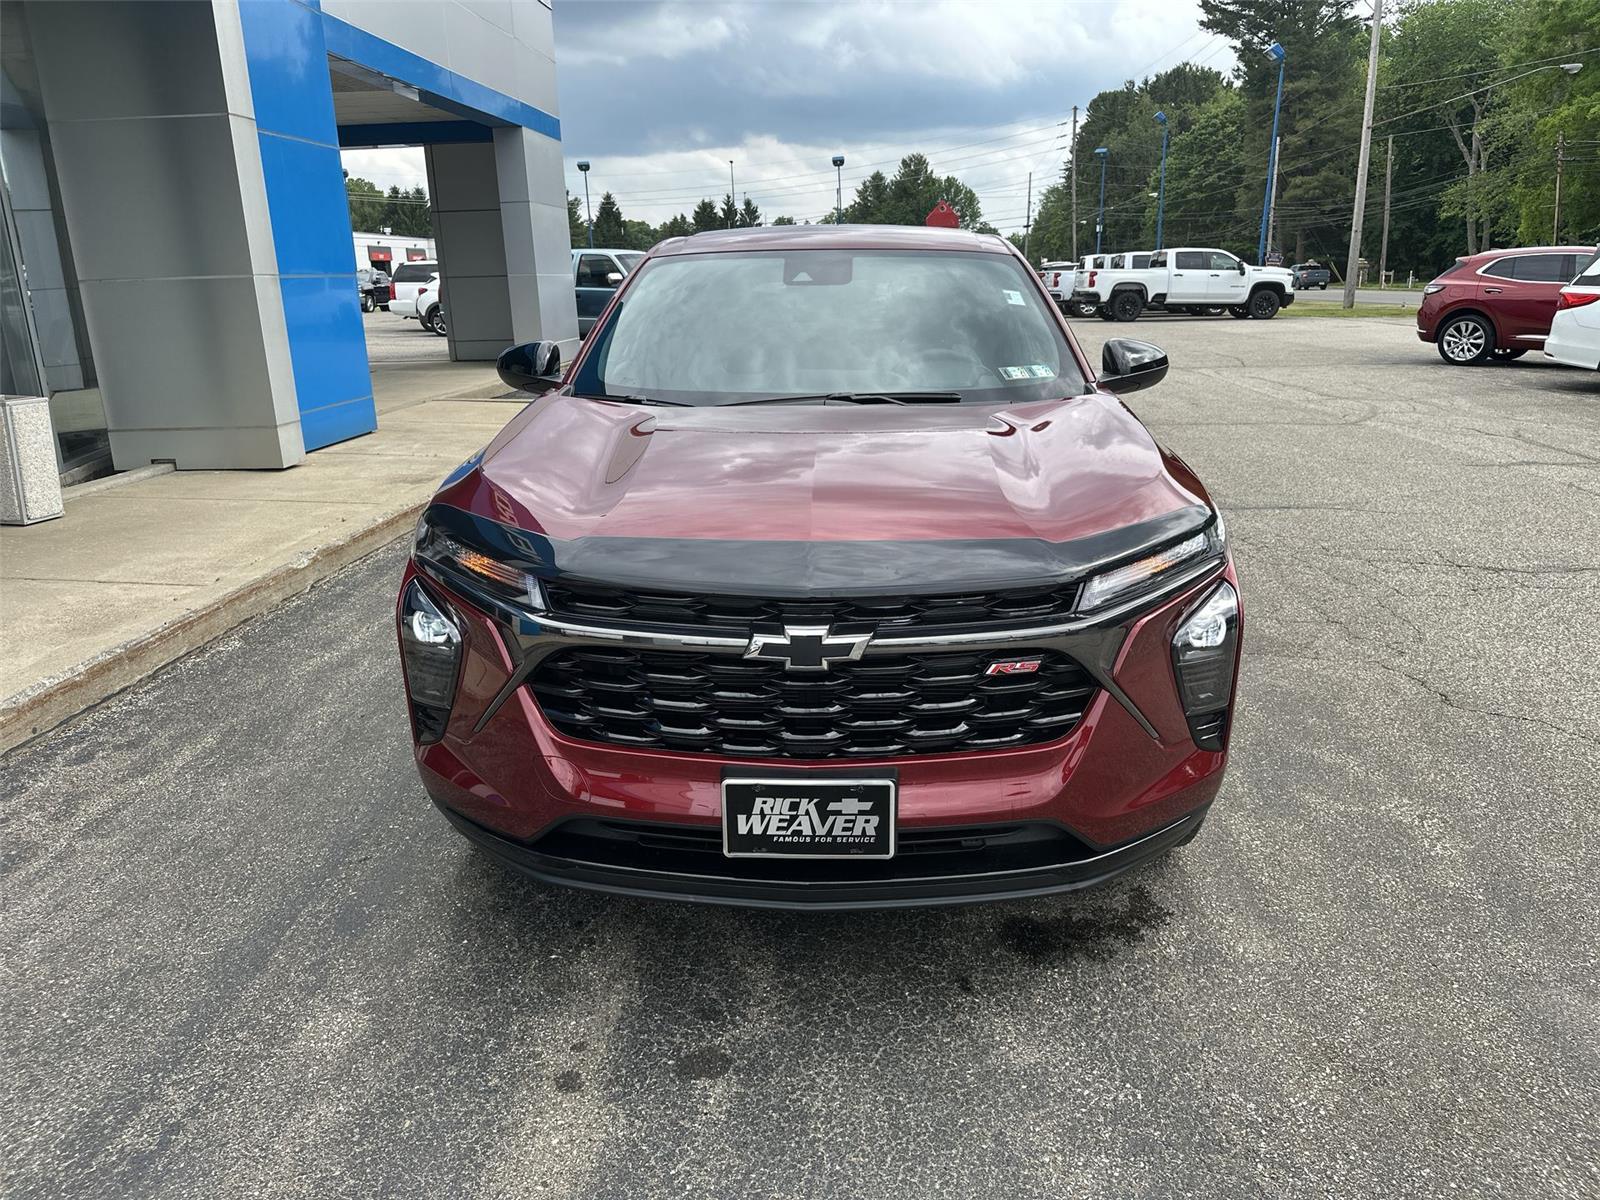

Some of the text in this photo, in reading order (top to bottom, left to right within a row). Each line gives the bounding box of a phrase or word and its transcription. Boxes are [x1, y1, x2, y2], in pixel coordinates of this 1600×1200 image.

[985, 661, 1041, 675] RS
[752, 798, 820, 815] RICK
[737, 814, 880, 836] WEAVER
